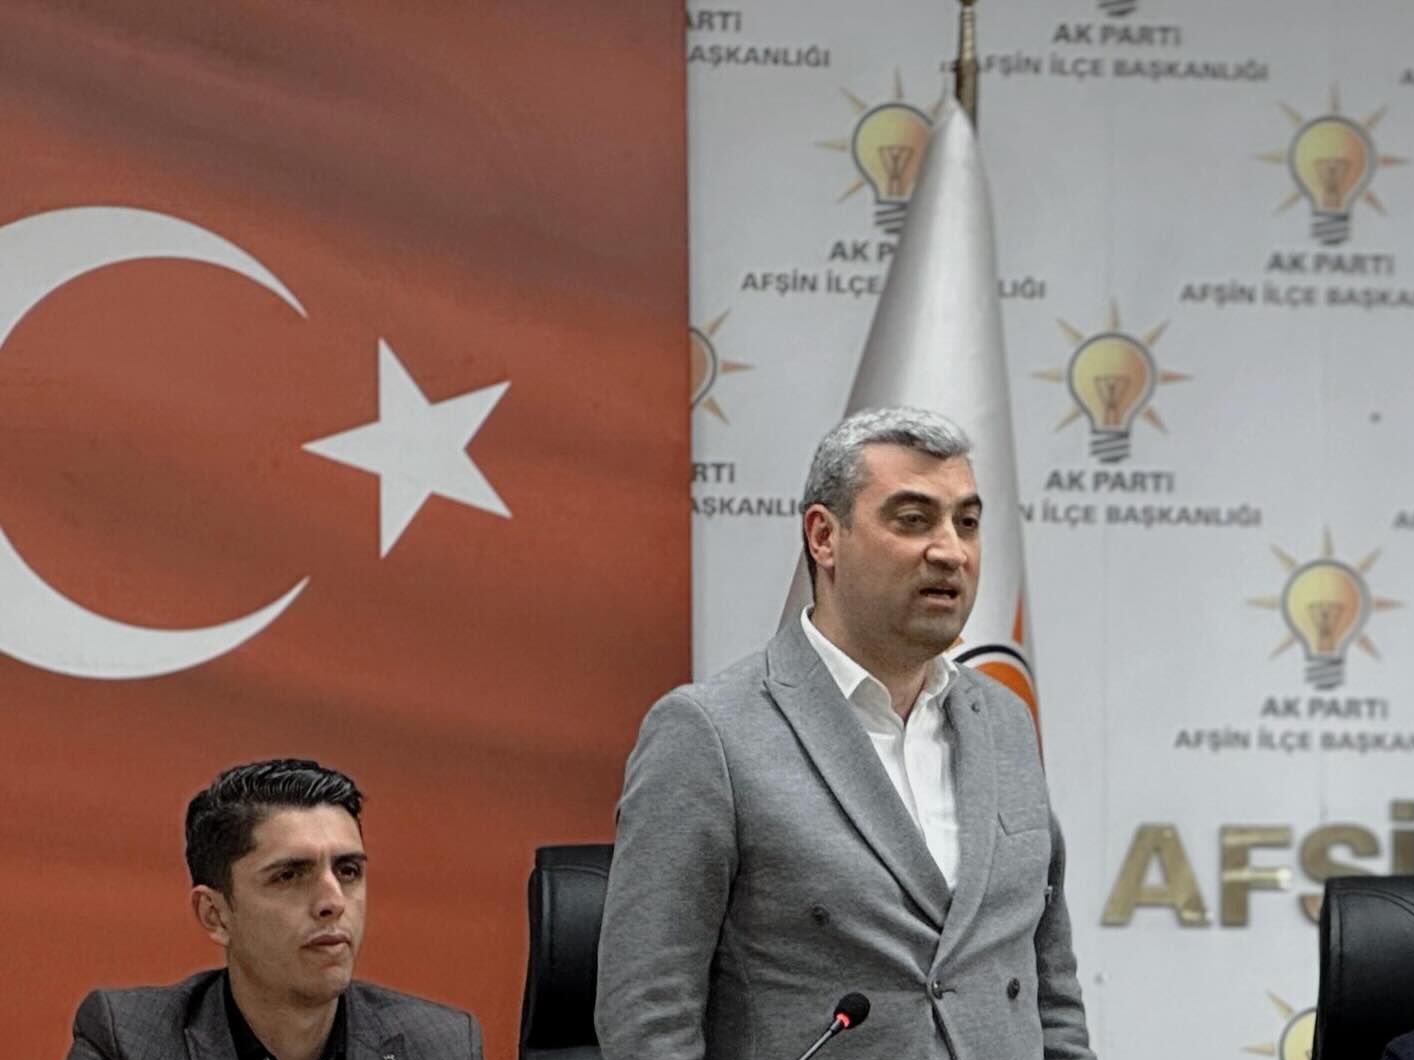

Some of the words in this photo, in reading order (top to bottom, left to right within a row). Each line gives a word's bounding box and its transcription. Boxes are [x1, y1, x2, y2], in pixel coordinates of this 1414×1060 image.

[1053, 24, 1092, 44] AK
[687, 45, 831, 68] AŞKANLIĞI
[1051, 53, 1103, 79] İLÇE
[828, 240, 870, 261] AK
[1266, 253, 1306, 273] AK
[741, 269, 818, 298] AFŞİN
[826, 269, 881, 298] İLÇE
[1181, 281, 1256, 307] AFŞİN
[1264, 282, 1316, 308] İLÇE
[1044, 470, 1085, 492] AK
[1042, 499, 1096, 528] İLÇE
[1260, 697, 1300, 718] AK
[1174, 728, 1250, 753] AFŞİN
[1257, 727, 1311, 754] İLÇE
